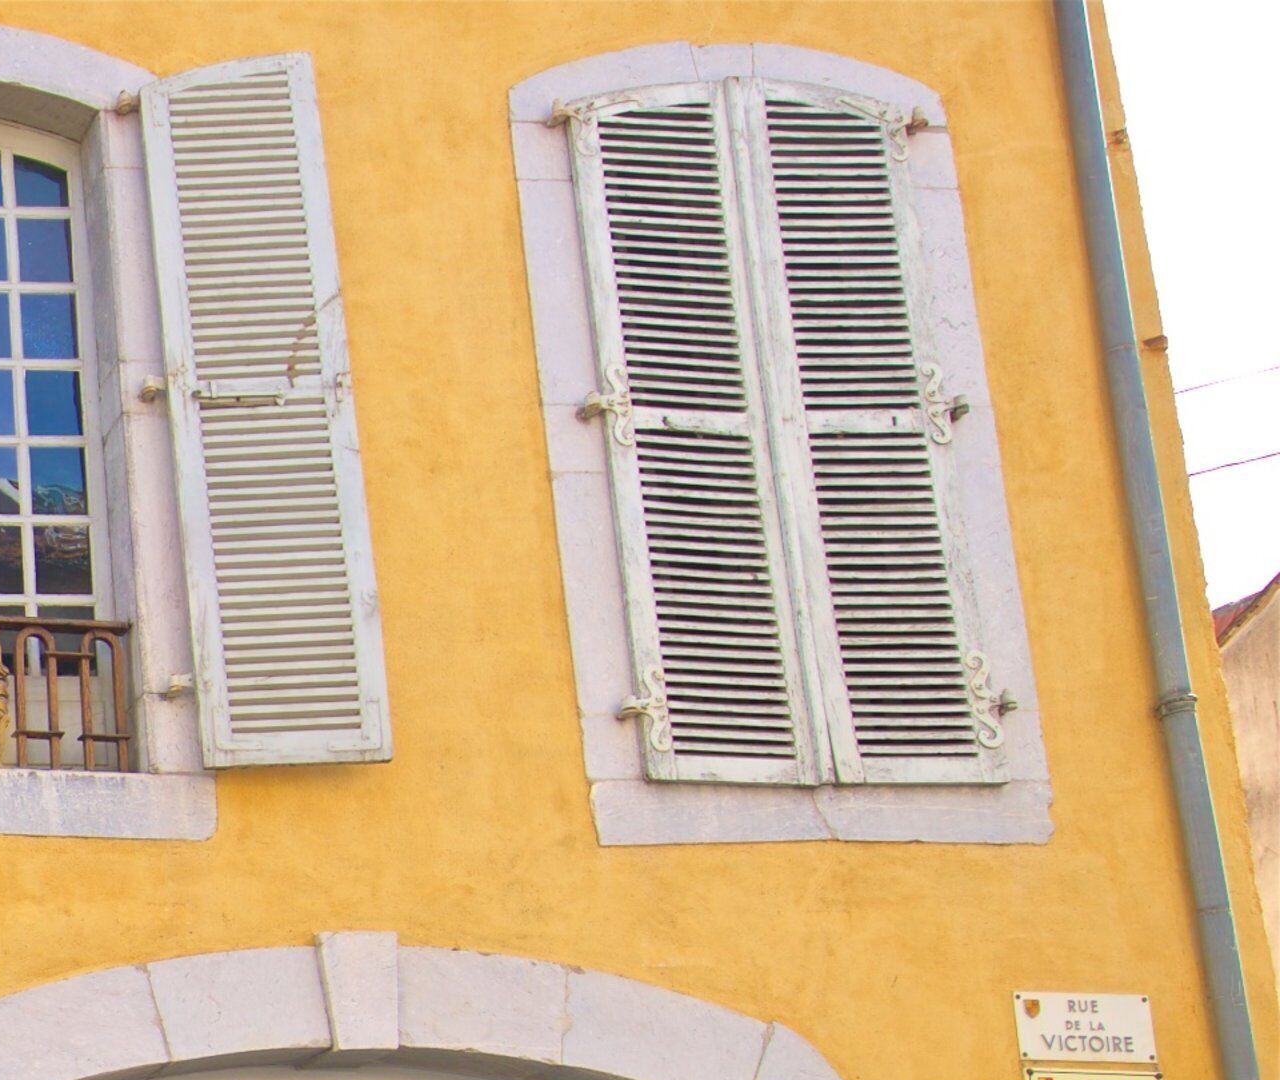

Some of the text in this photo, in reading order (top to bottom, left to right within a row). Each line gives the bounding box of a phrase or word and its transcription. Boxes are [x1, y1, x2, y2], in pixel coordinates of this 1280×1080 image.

[1067, 1000, 1099, 1013] RUE
[1065, 1020, 1105, 1031] DE LA
[1040, 1034, 1135, 1053] VICTOIRE
